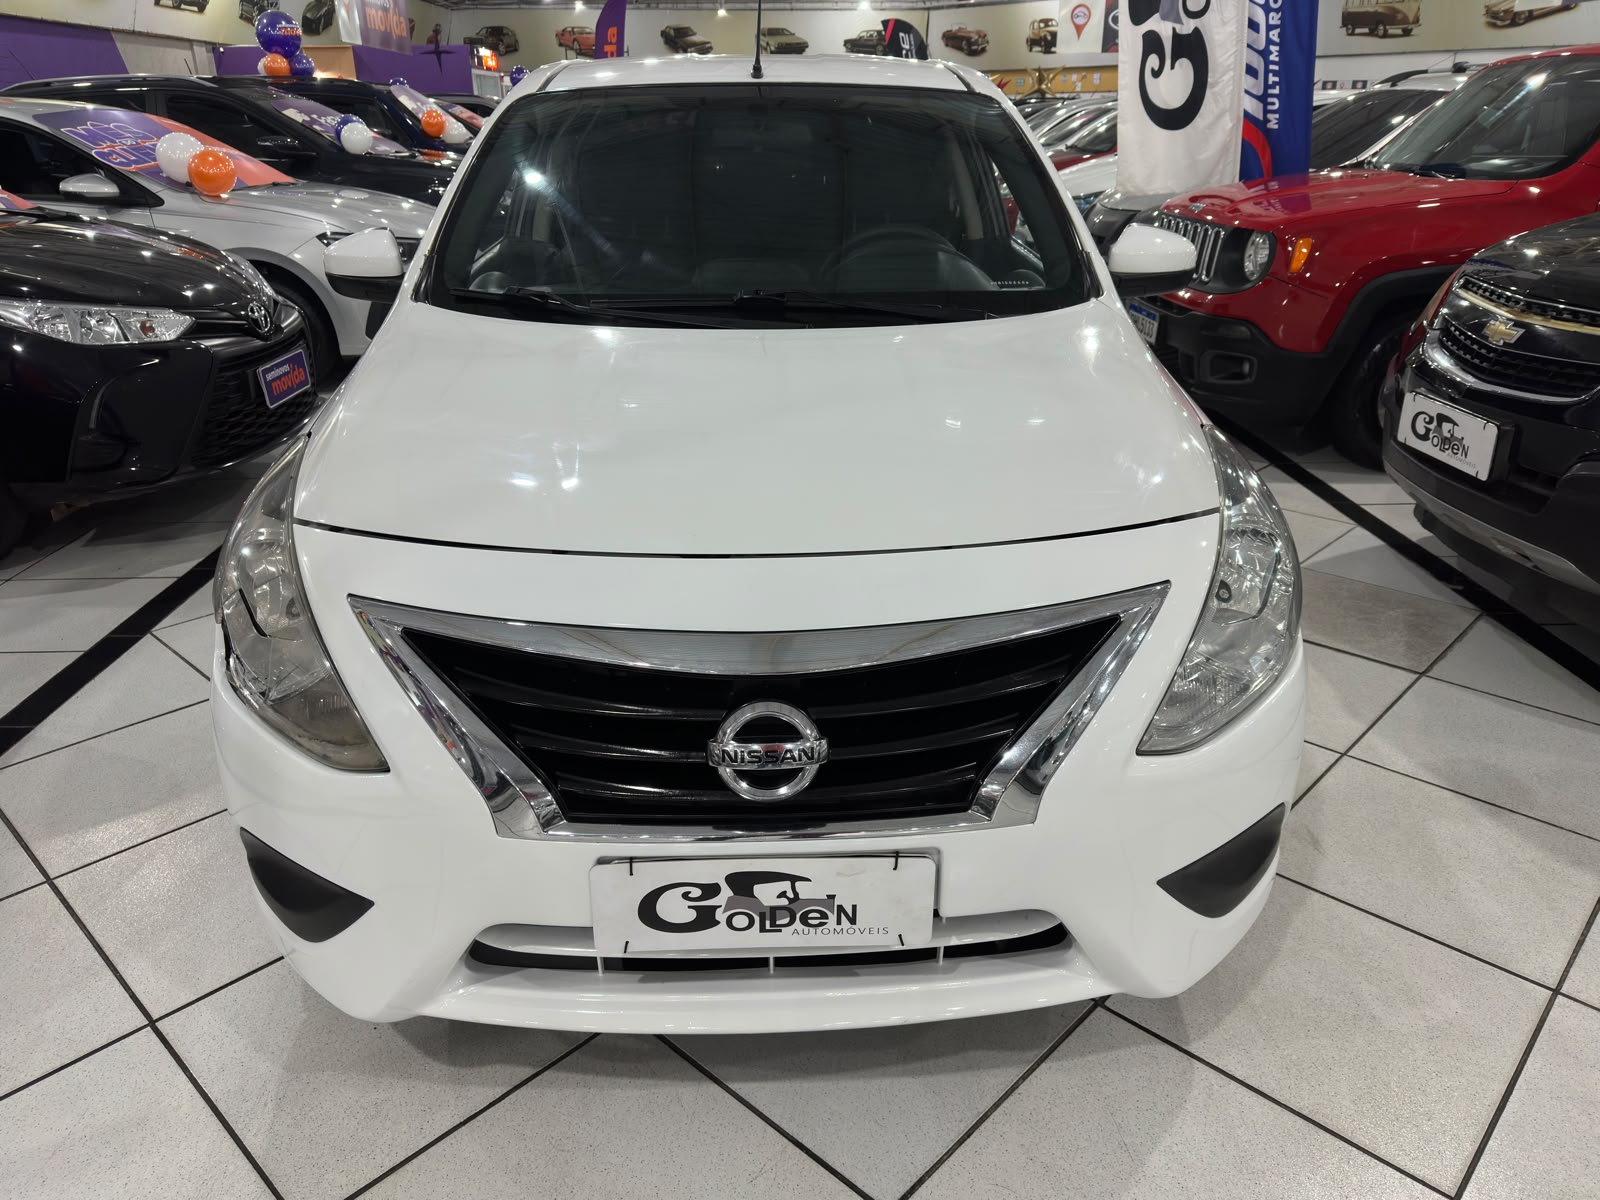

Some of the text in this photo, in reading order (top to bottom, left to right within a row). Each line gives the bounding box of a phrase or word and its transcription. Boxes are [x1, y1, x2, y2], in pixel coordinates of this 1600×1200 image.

[265, 364, 290, 381] seminovos
[272, 363, 304, 395] movida
[721, 746, 816, 764] NISSAN
[791, 926, 889, 936] AUTOMÓVEIS
